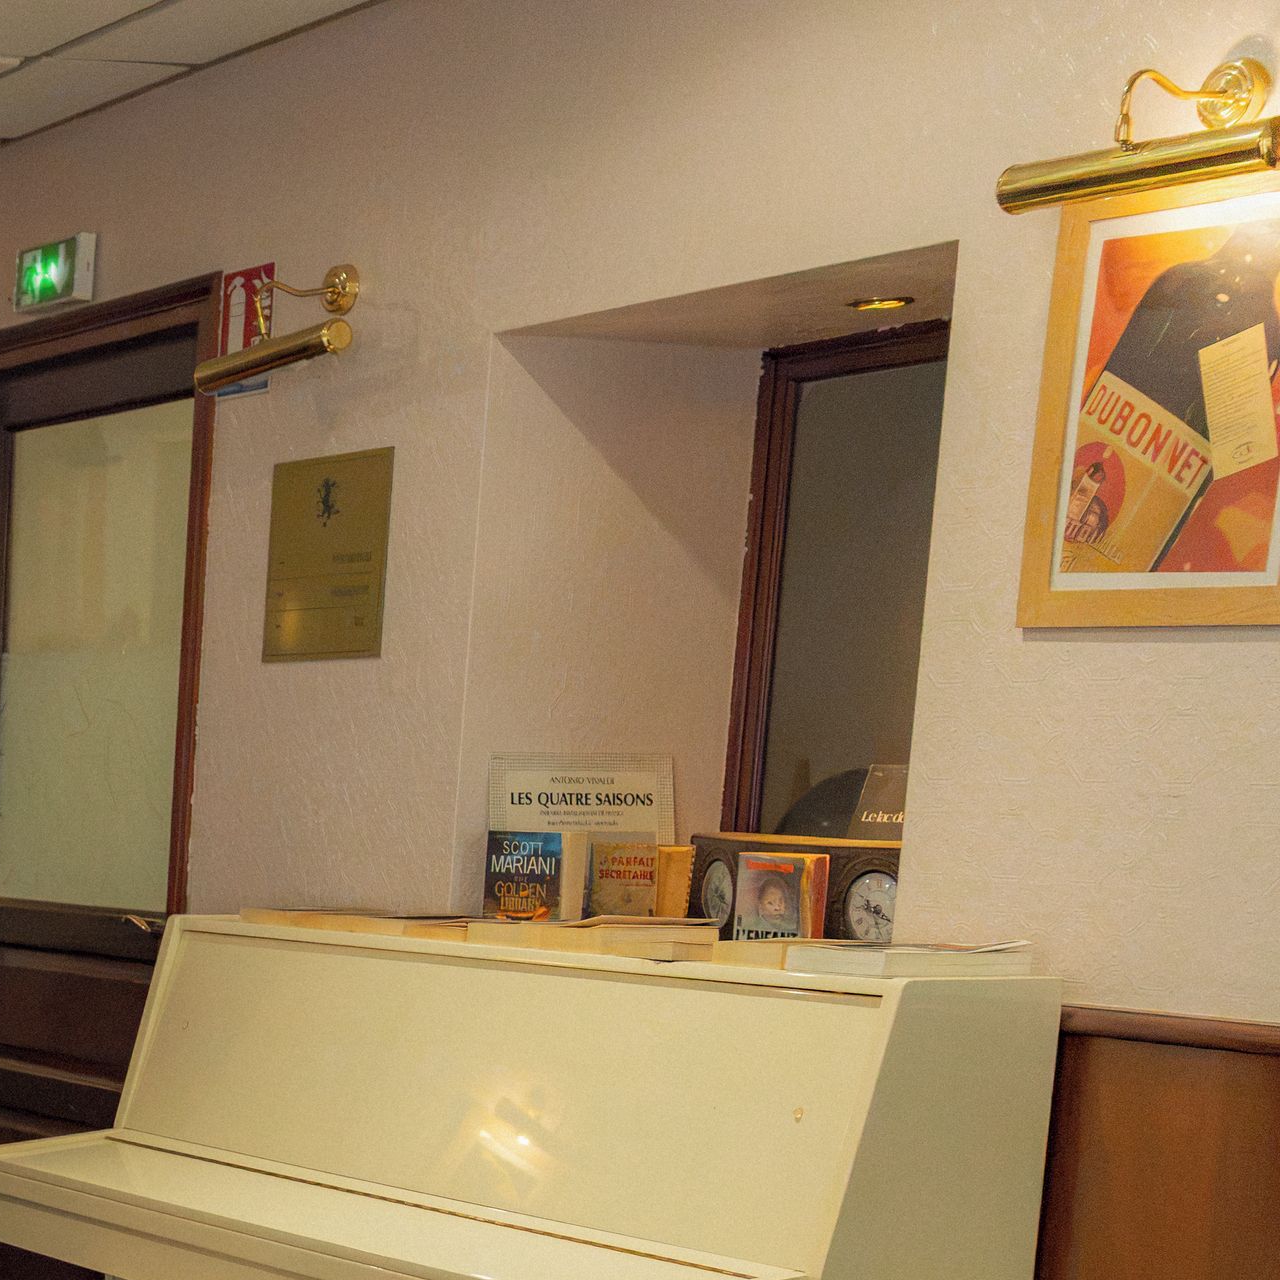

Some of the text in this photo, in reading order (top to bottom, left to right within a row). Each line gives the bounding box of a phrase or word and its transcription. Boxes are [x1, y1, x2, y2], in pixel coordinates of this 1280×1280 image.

[1086, 384, 1209, 489] DUBONNET
[510, 792, 654, 808] LES QUATRE SAISONS
[861, 811, 877, 822] Le
[502, 841, 544, 855] SCOTT
[491, 854, 556, 876] MARIANI
[495, 880, 547, 900] GOLDEN
